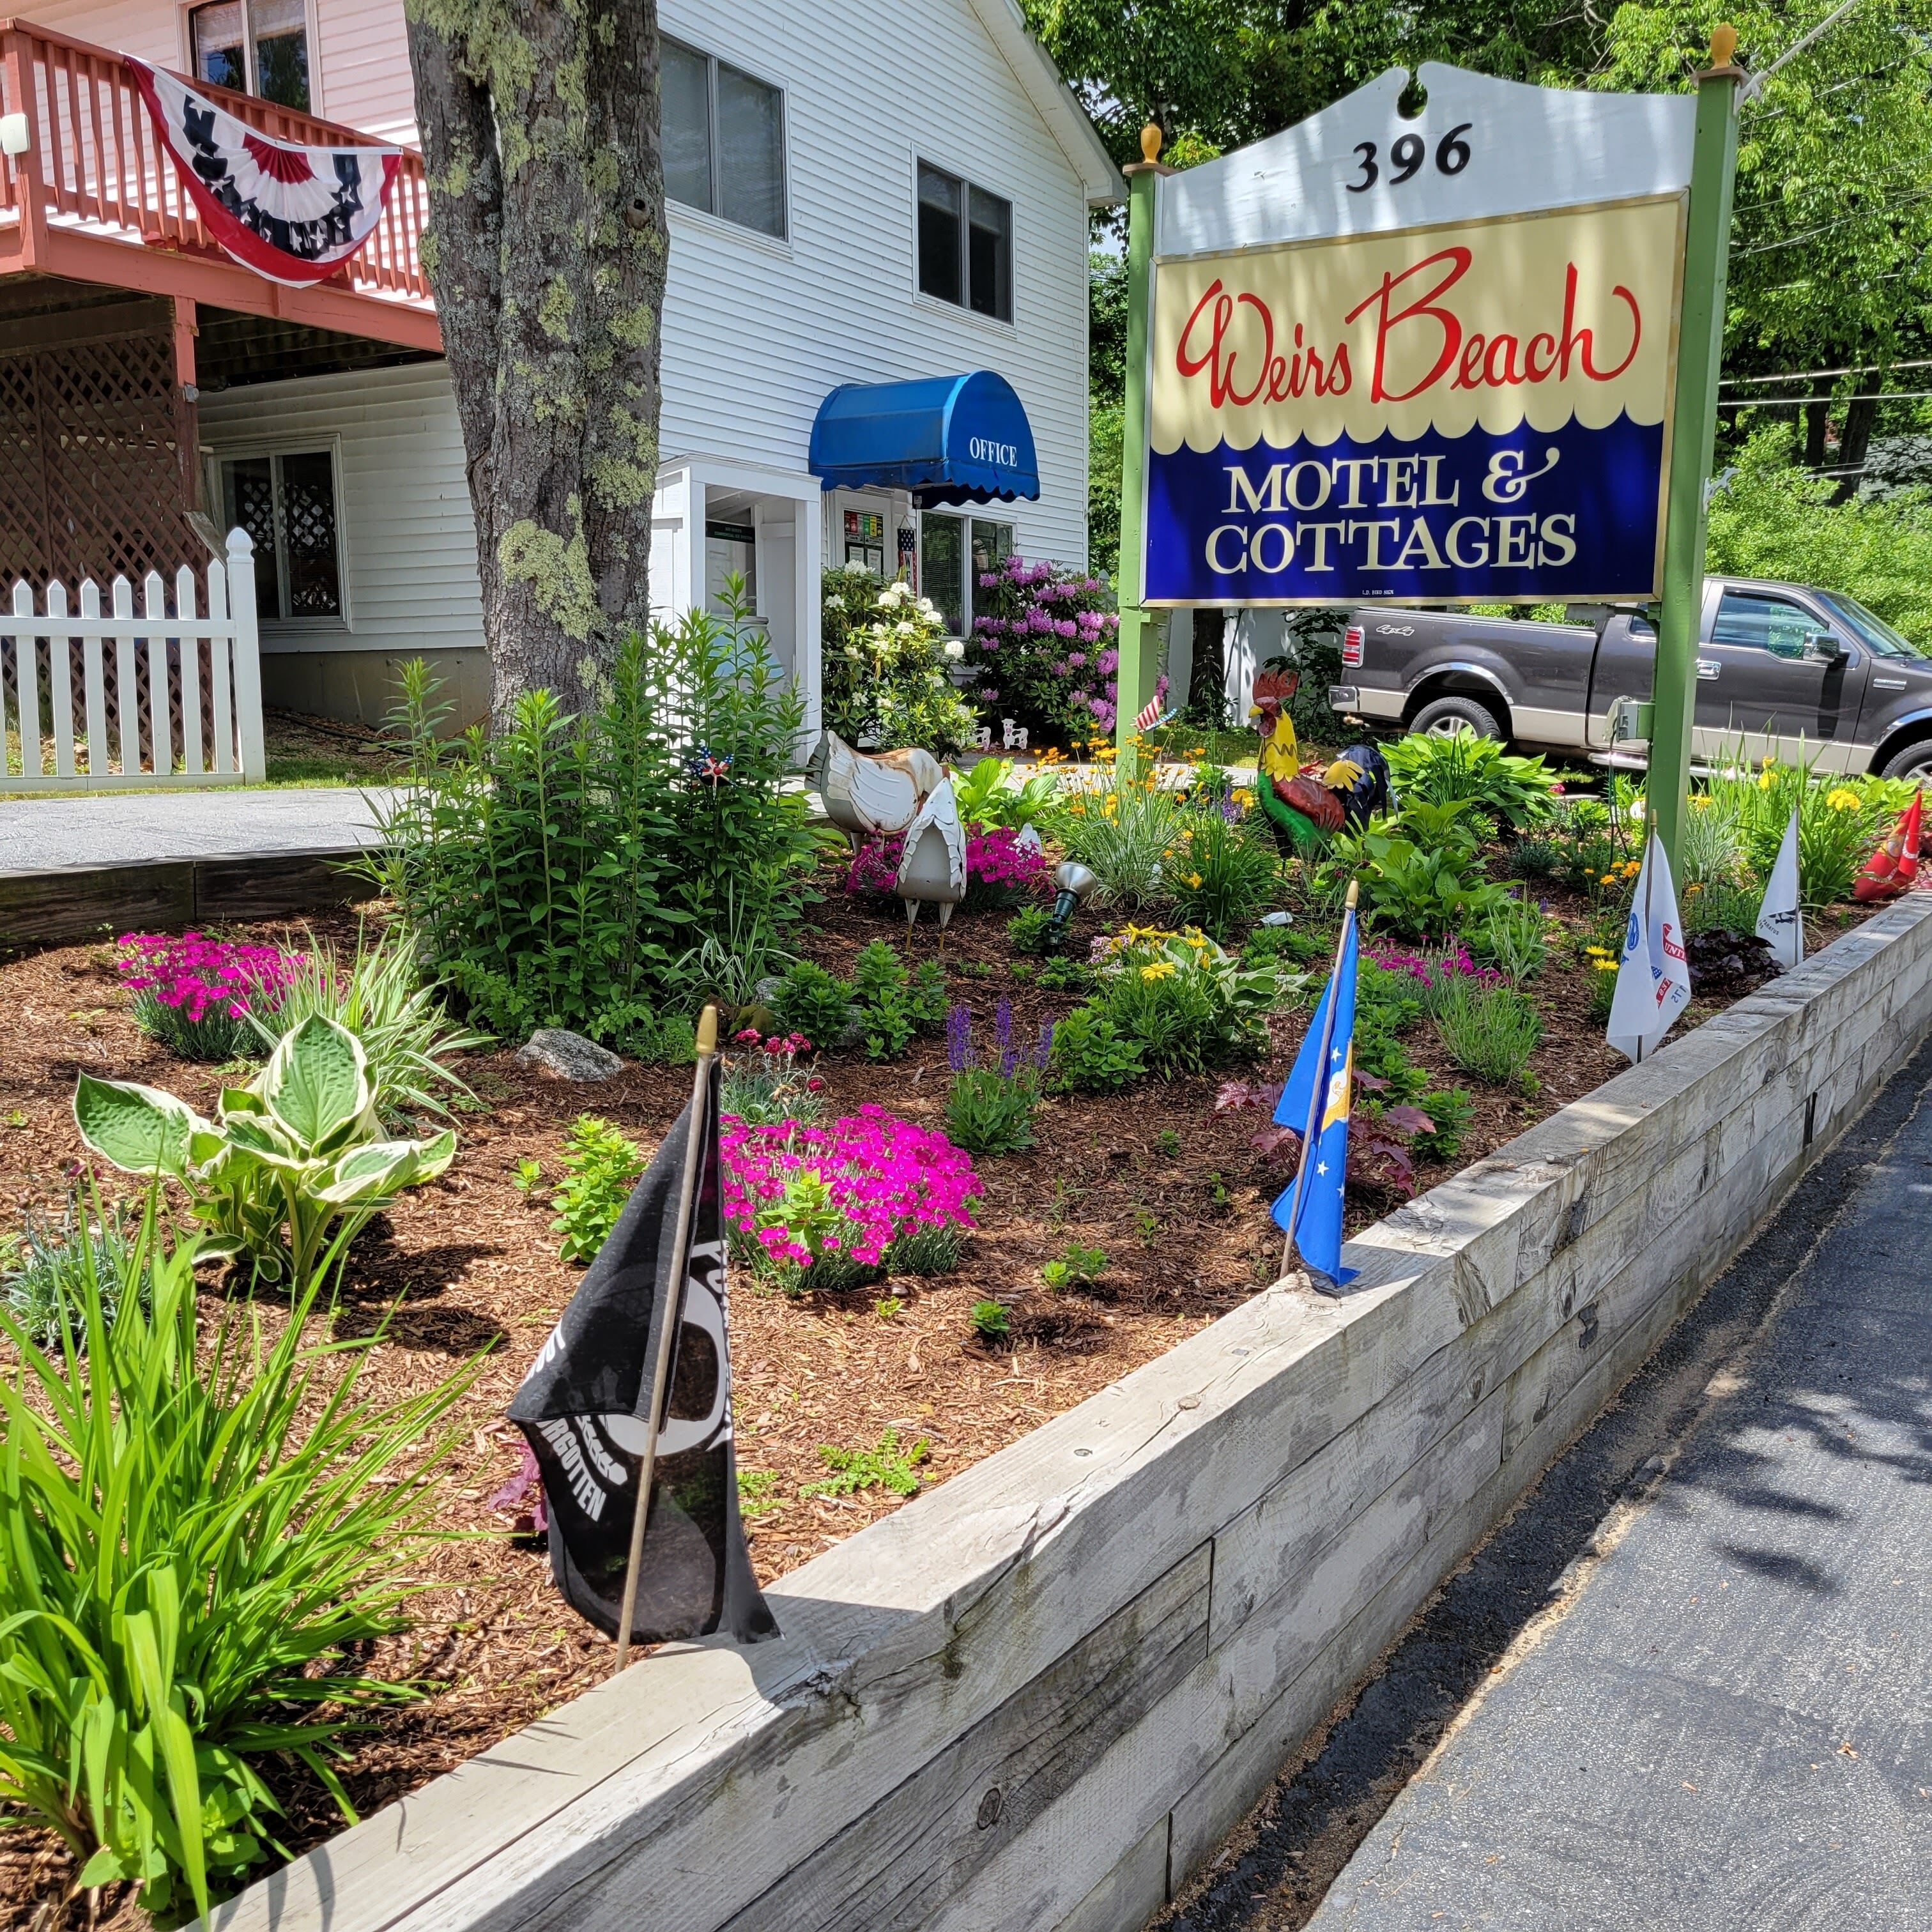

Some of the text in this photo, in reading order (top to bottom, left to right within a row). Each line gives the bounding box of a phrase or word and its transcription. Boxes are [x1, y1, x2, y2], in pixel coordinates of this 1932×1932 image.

[1346, 123, 1473, 193] 396
[1176, 246, 1641, 410] Weirs Beach
[969, 436, 1017, 467] OFFICE
[1221, 447, 1560, 514] MOTEL &
[1205, 512, 1577, 574] COTTAGES
[1376, 624, 1415, 636] 4x4
[1664, 942, 1685, 959] UNIT
[535, 1417, 607, 1522] RGOTTEN
